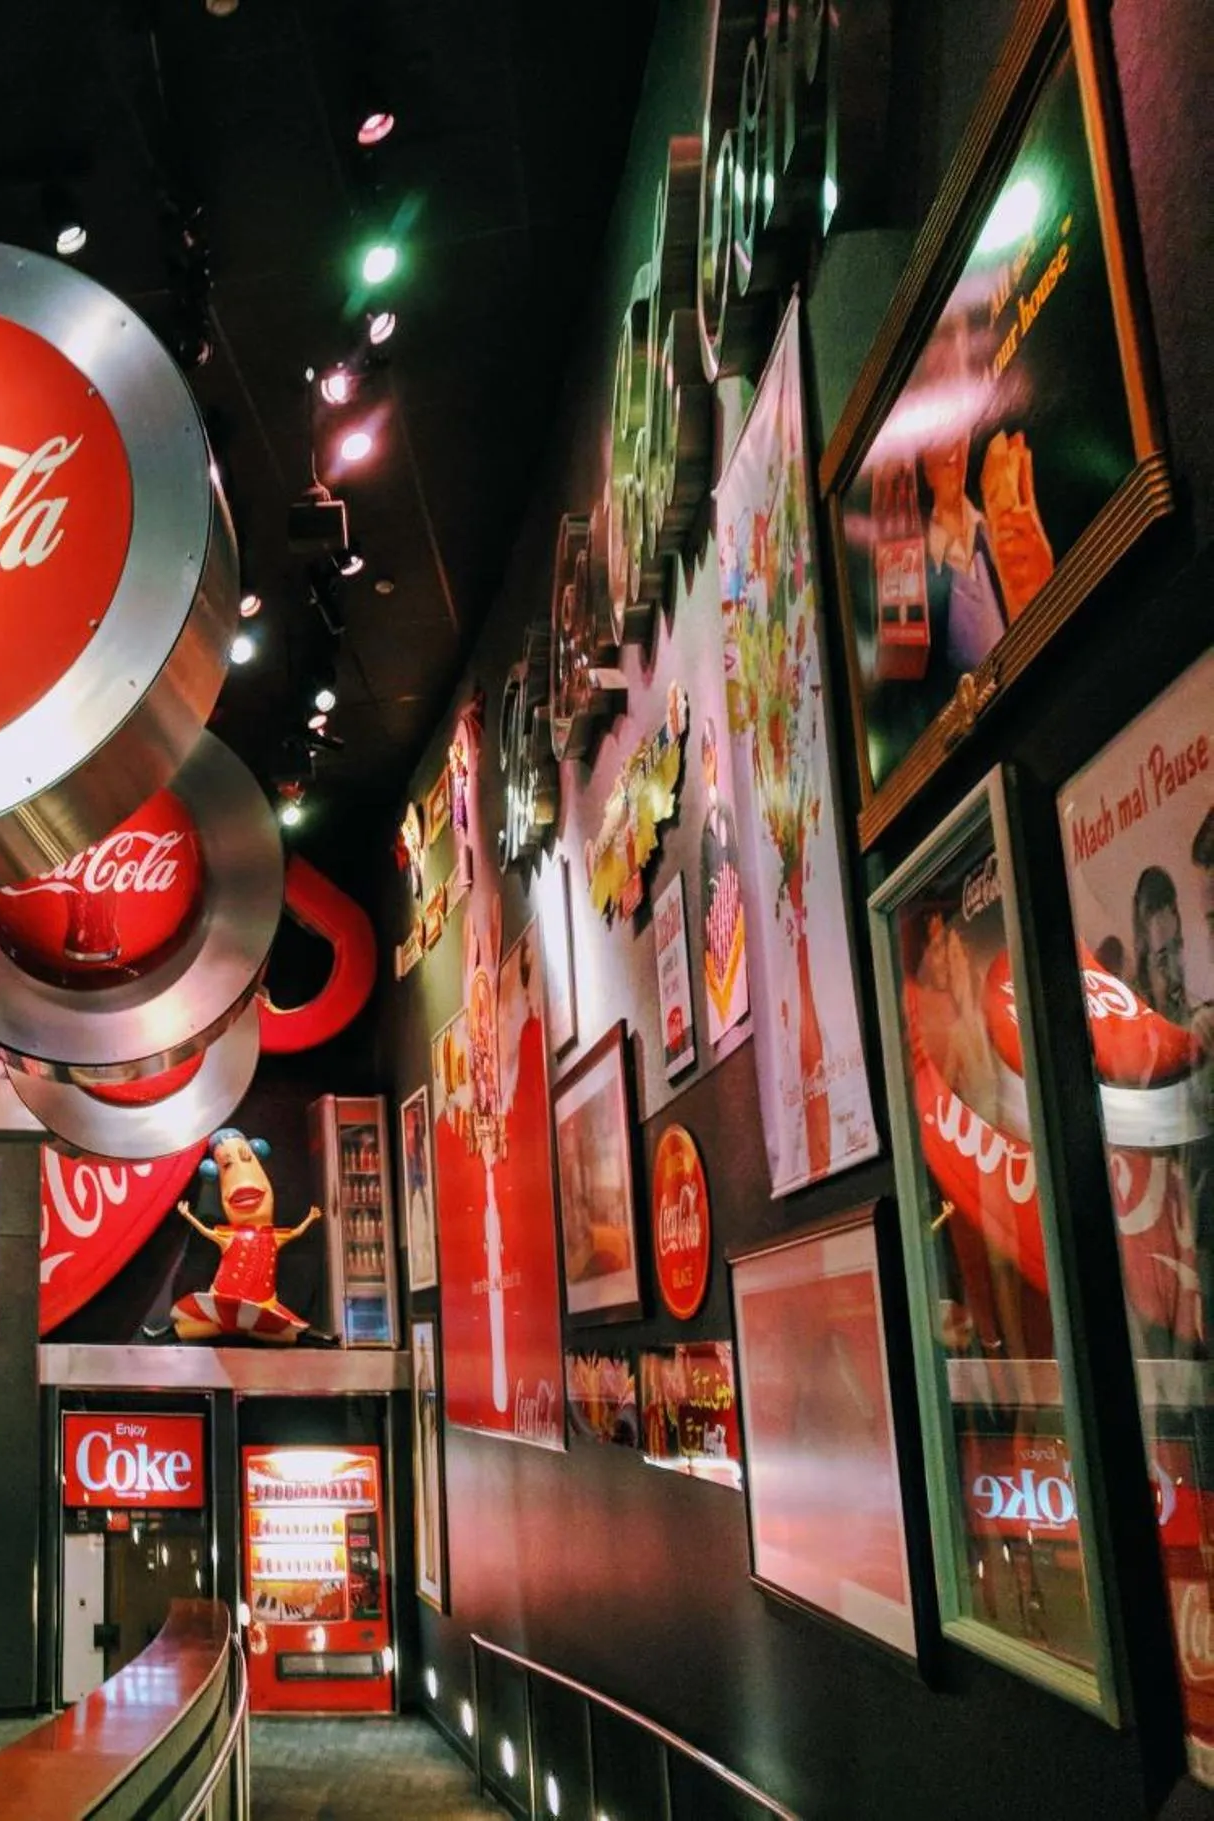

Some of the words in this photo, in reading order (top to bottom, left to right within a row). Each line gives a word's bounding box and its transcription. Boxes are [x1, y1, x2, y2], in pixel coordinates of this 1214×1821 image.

[1072, 794, 1115, 866] Mach
[1117, 763, 1149, 831] mal
[1148, 733, 1211, 807] Pause
[75, 1430, 192, 1492] Coke
[115, 1423, 147, 1438] Enjoy
